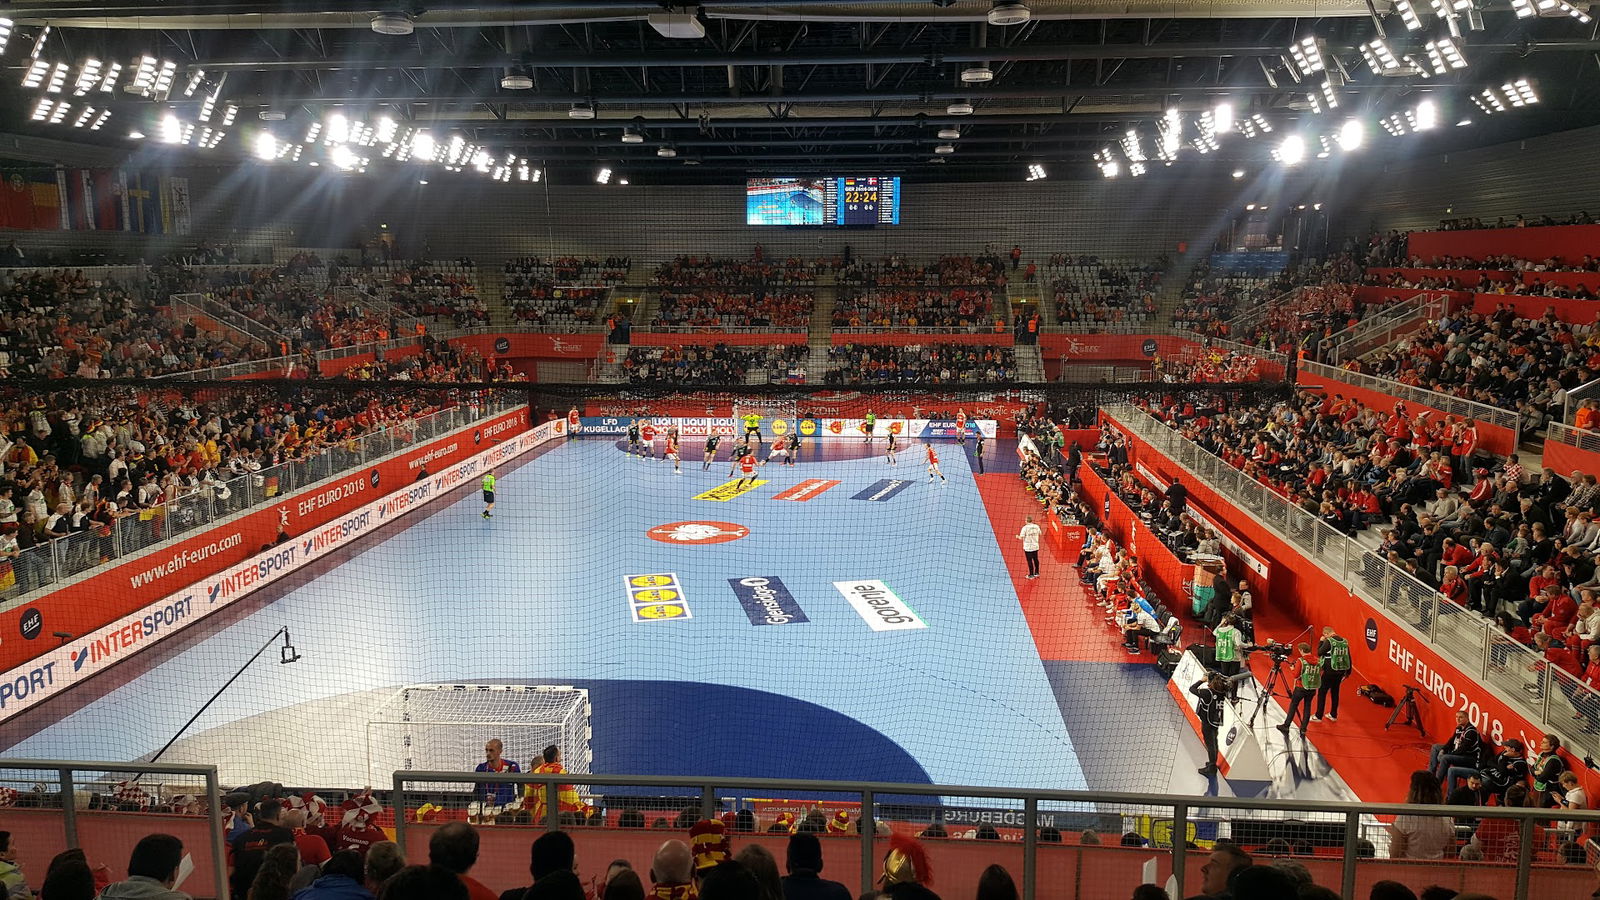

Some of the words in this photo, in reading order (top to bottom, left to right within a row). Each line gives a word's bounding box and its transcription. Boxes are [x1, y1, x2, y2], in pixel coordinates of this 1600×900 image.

[845, 191, 878, 203] 22:24
[584, 425, 628, 433] KUGELLAG
[602, 418, 618, 426] LFD
[683, 418, 707, 426] LIQUI
[683, 426, 707, 434] MOLY
[441, 460, 479, 489] INTERSPORT
[298, 503, 316, 517] EHF
[317, 487, 343, 509] EURO
[343, 478, 366, 498] 2018
[386, 483, 432, 516] INTERSPORT
[313, 511, 371, 551] INTERSPORT
[130, 531, 242, 589] www.ehf-euro.com
[220, 547, 297, 598] INTERSPORT
[851, 584, 914, 625] gorenje
[23, 613, 40, 631] EHF
[90, 596, 193, 664] INTERSPORT
[1366, 628, 1377, 637] EHF
[1388, 639, 1414, 673] EHF
[1414, 658, 1456, 708] EURO
[1458, 692, 1504, 747] 2018
